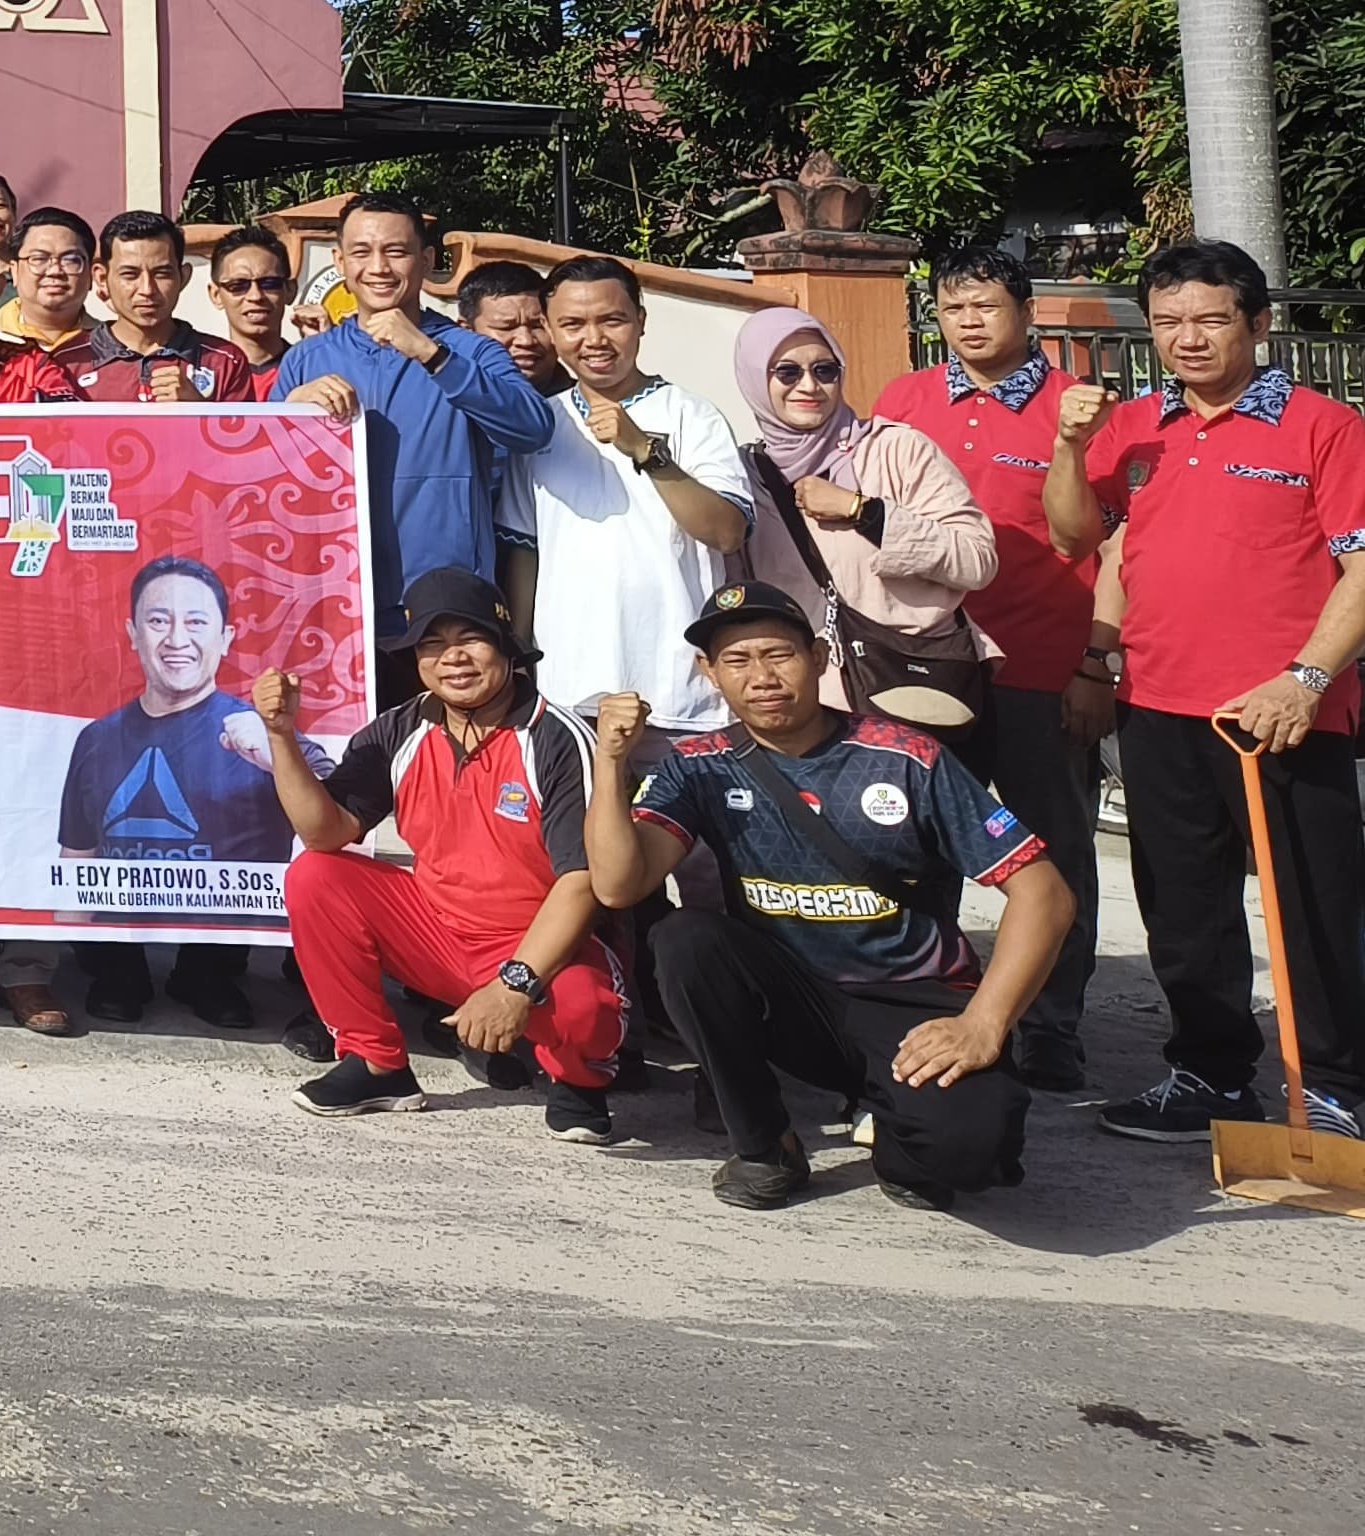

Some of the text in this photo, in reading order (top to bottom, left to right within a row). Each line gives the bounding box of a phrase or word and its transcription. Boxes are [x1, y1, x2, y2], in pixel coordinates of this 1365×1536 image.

[70, 474, 108, 487] KALTENG
[71, 491, 105, 504] BERKAH
[72, 508, 115, 521] MAJU DAN
[72, 525, 135, 538] BERMARTABAT
[50, 865, 70, 886] H.
[76, 866, 111, 887] EDY
[117, 867, 214, 892] PRATOWO,
[77, 890, 116, 906] WAKIL
[119, 891, 183, 907] GUBERNUR
[186, 892, 263, 909] KALIMANTAN
[742, 880, 899, 919] DISPERKIM
